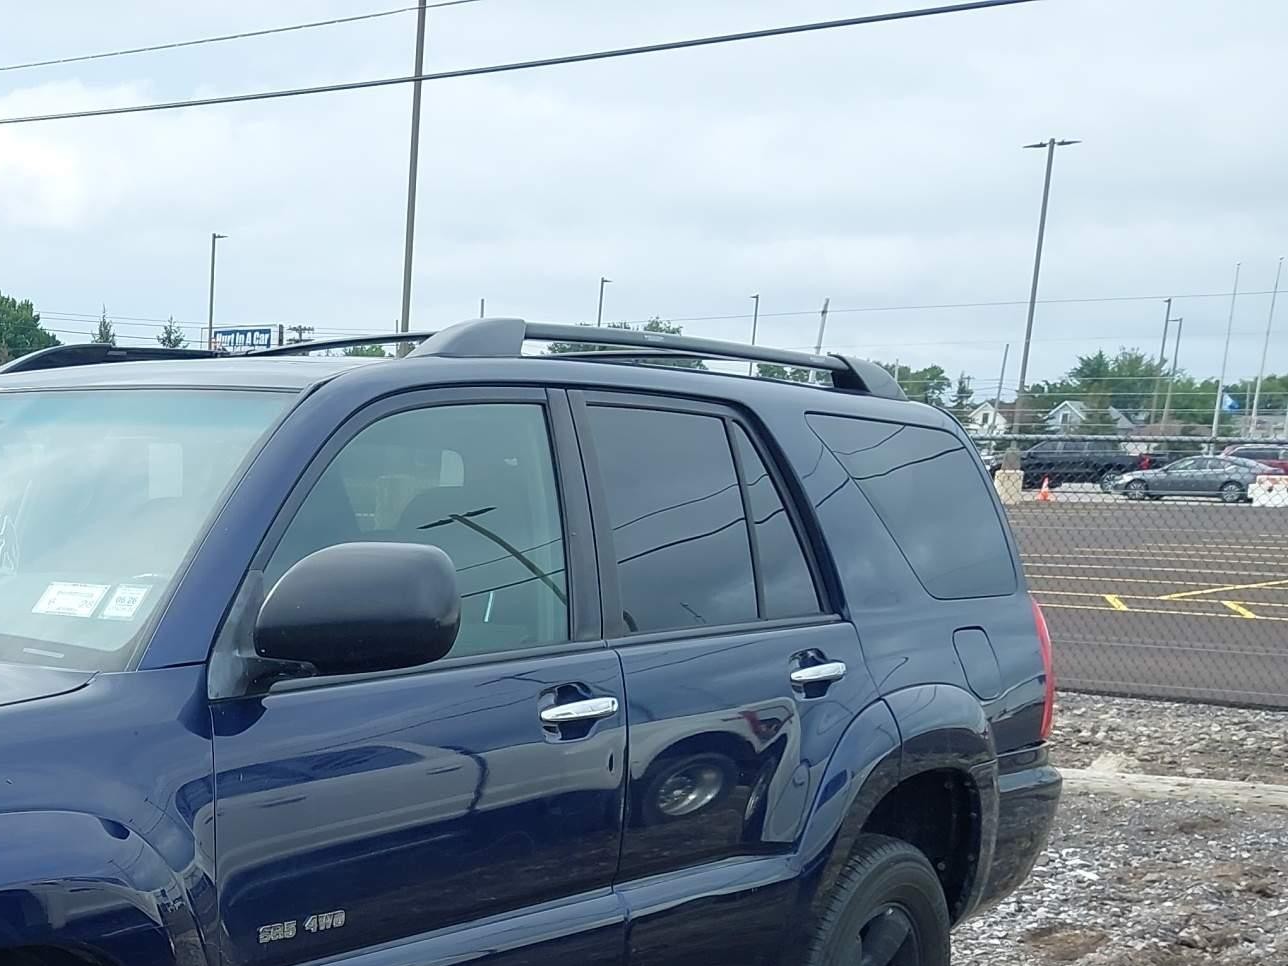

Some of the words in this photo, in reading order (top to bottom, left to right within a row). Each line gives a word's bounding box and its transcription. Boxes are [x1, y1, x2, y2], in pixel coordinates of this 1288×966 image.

[245, 331, 252, 346] A
[253, 330, 270, 345] Car
[258, 920, 297, 944] SR5
[304, 909, 346, 933] 4WD
